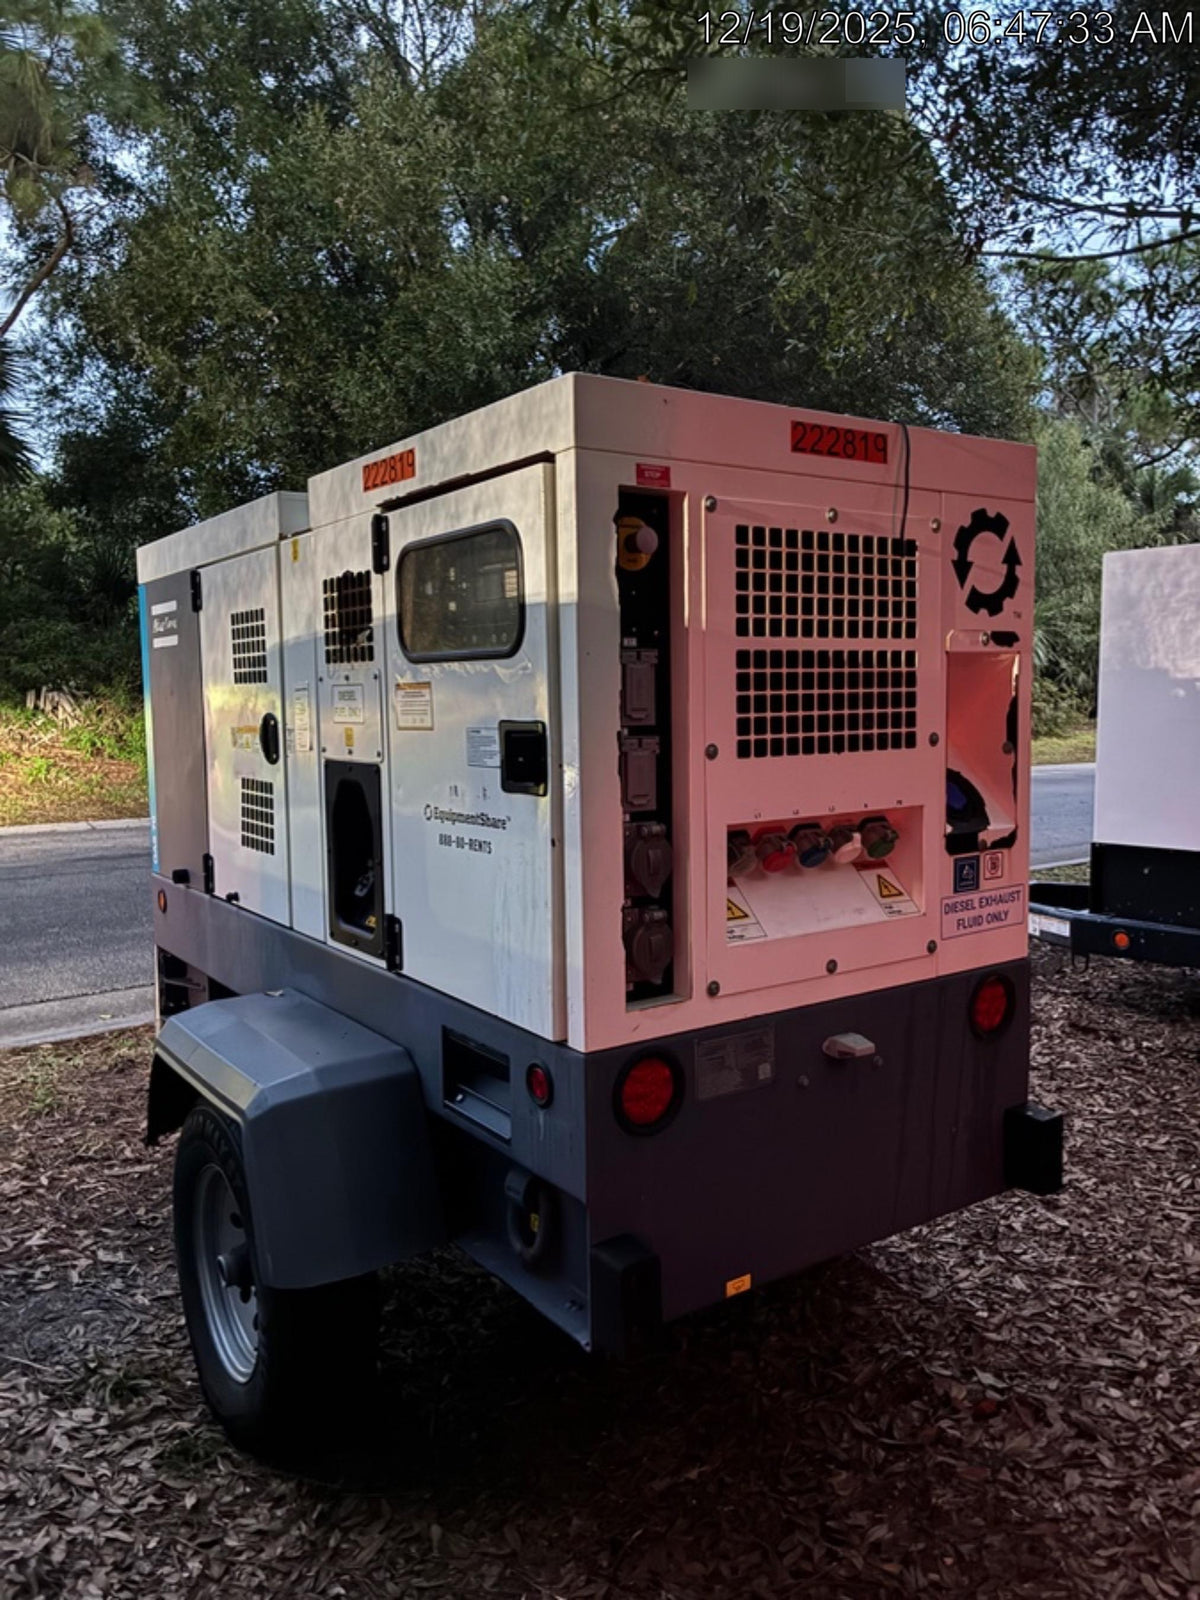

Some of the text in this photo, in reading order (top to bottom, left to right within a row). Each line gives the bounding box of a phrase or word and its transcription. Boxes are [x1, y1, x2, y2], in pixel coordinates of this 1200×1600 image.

[792, 421, 888, 464] 222819
[363, 449, 415, 491] 222819
[944, 890, 1021, 915] DIESEL EXHAUST
[956, 910, 1009, 930] FLUID ONLY
